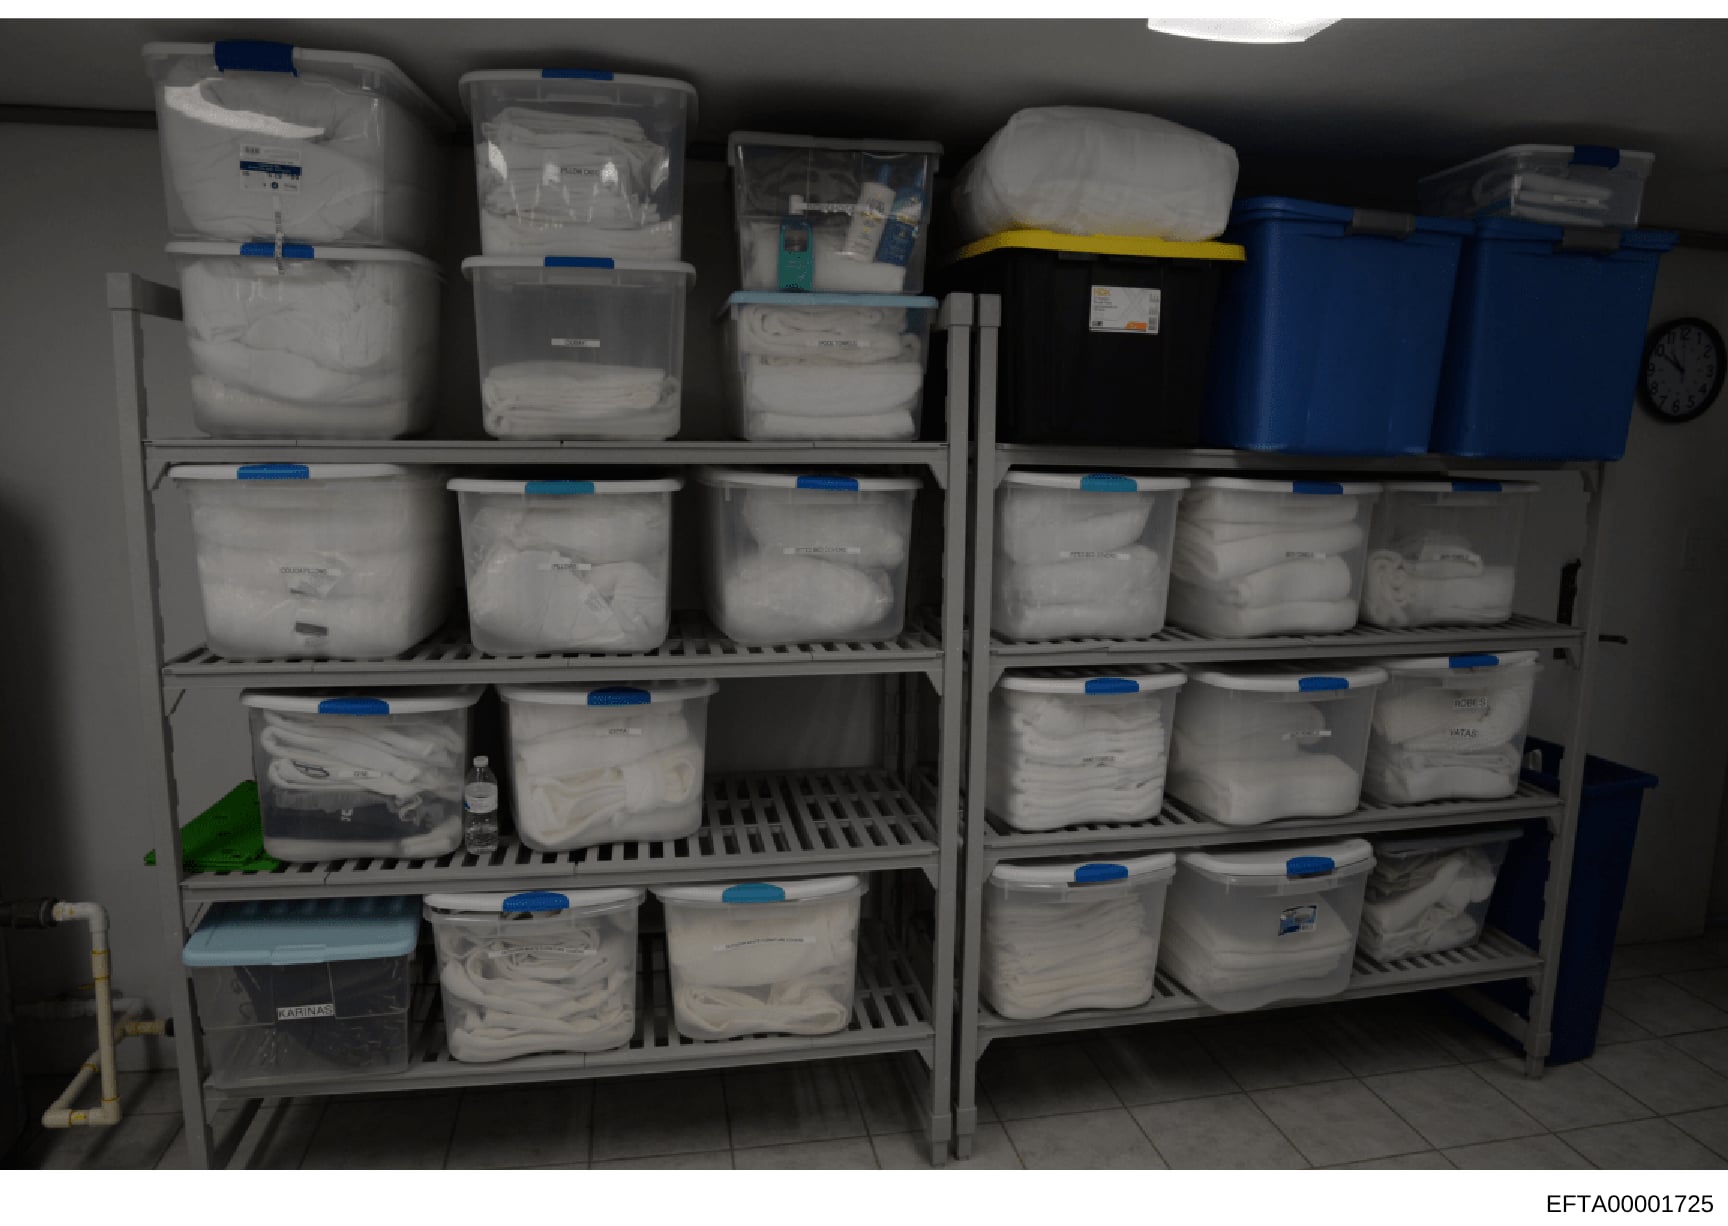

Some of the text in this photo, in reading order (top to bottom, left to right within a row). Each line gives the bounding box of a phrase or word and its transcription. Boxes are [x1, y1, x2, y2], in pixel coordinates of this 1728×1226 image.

[1666, 330, 1675, 345] 11
[1680, 327, 1691, 340] 12
[1696, 331, 1702, 345] 1
[1703, 343, 1713, 358] 2
[1647, 362, 1655, 376] 9
[1705, 364, 1714, 378] 3
[1650, 381, 1659, 395] 8
[1697, 383, 1707, 395] 4
[1659, 395, 1668, 409] 7
[1672, 400, 1681, 414] 6
[1687, 395, 1696, 409] 5
[278, 1004, 332, 1018] KARINAS
